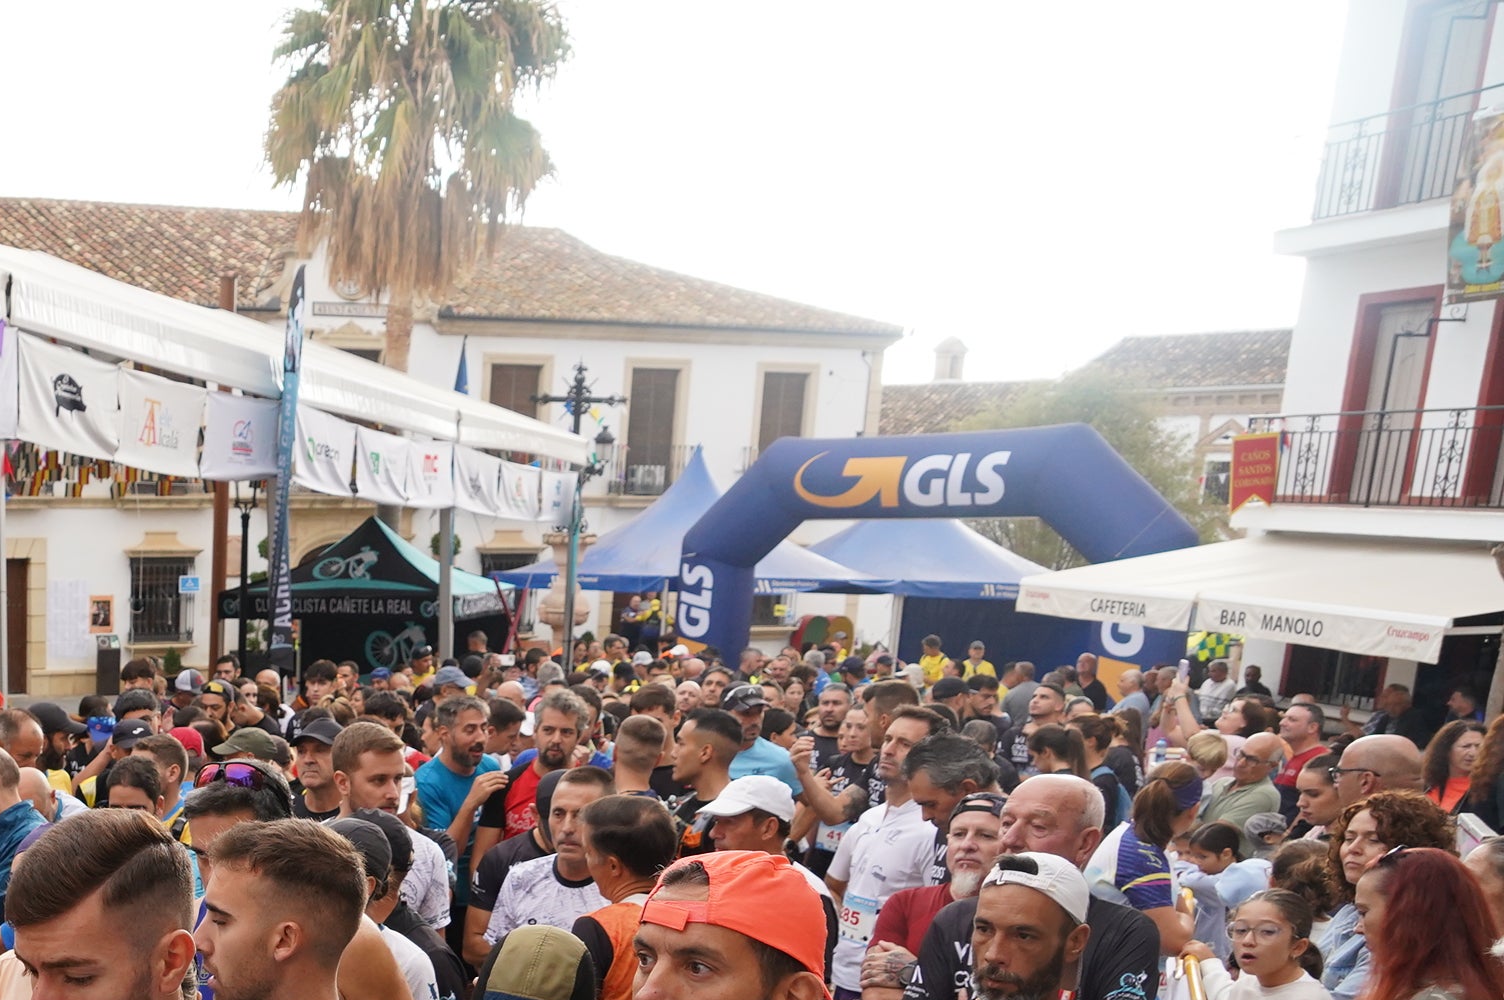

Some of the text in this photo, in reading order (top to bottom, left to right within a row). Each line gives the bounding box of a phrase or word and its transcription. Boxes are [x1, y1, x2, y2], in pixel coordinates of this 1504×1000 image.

[904, 451, 1008, 507] GLS
[329, 595, 369, 613] CAÑETE
[370, 599, 385, 613] LA
[386, 599, 414, 614] REAL
[679, 563, 714, 638] GLS
[1090, 598, 1146, 618] CAFETERIA
[1220, 609, 1324, 637] BAR MANOLO
[1387, 625, 1430, 642] Cruzcampo
